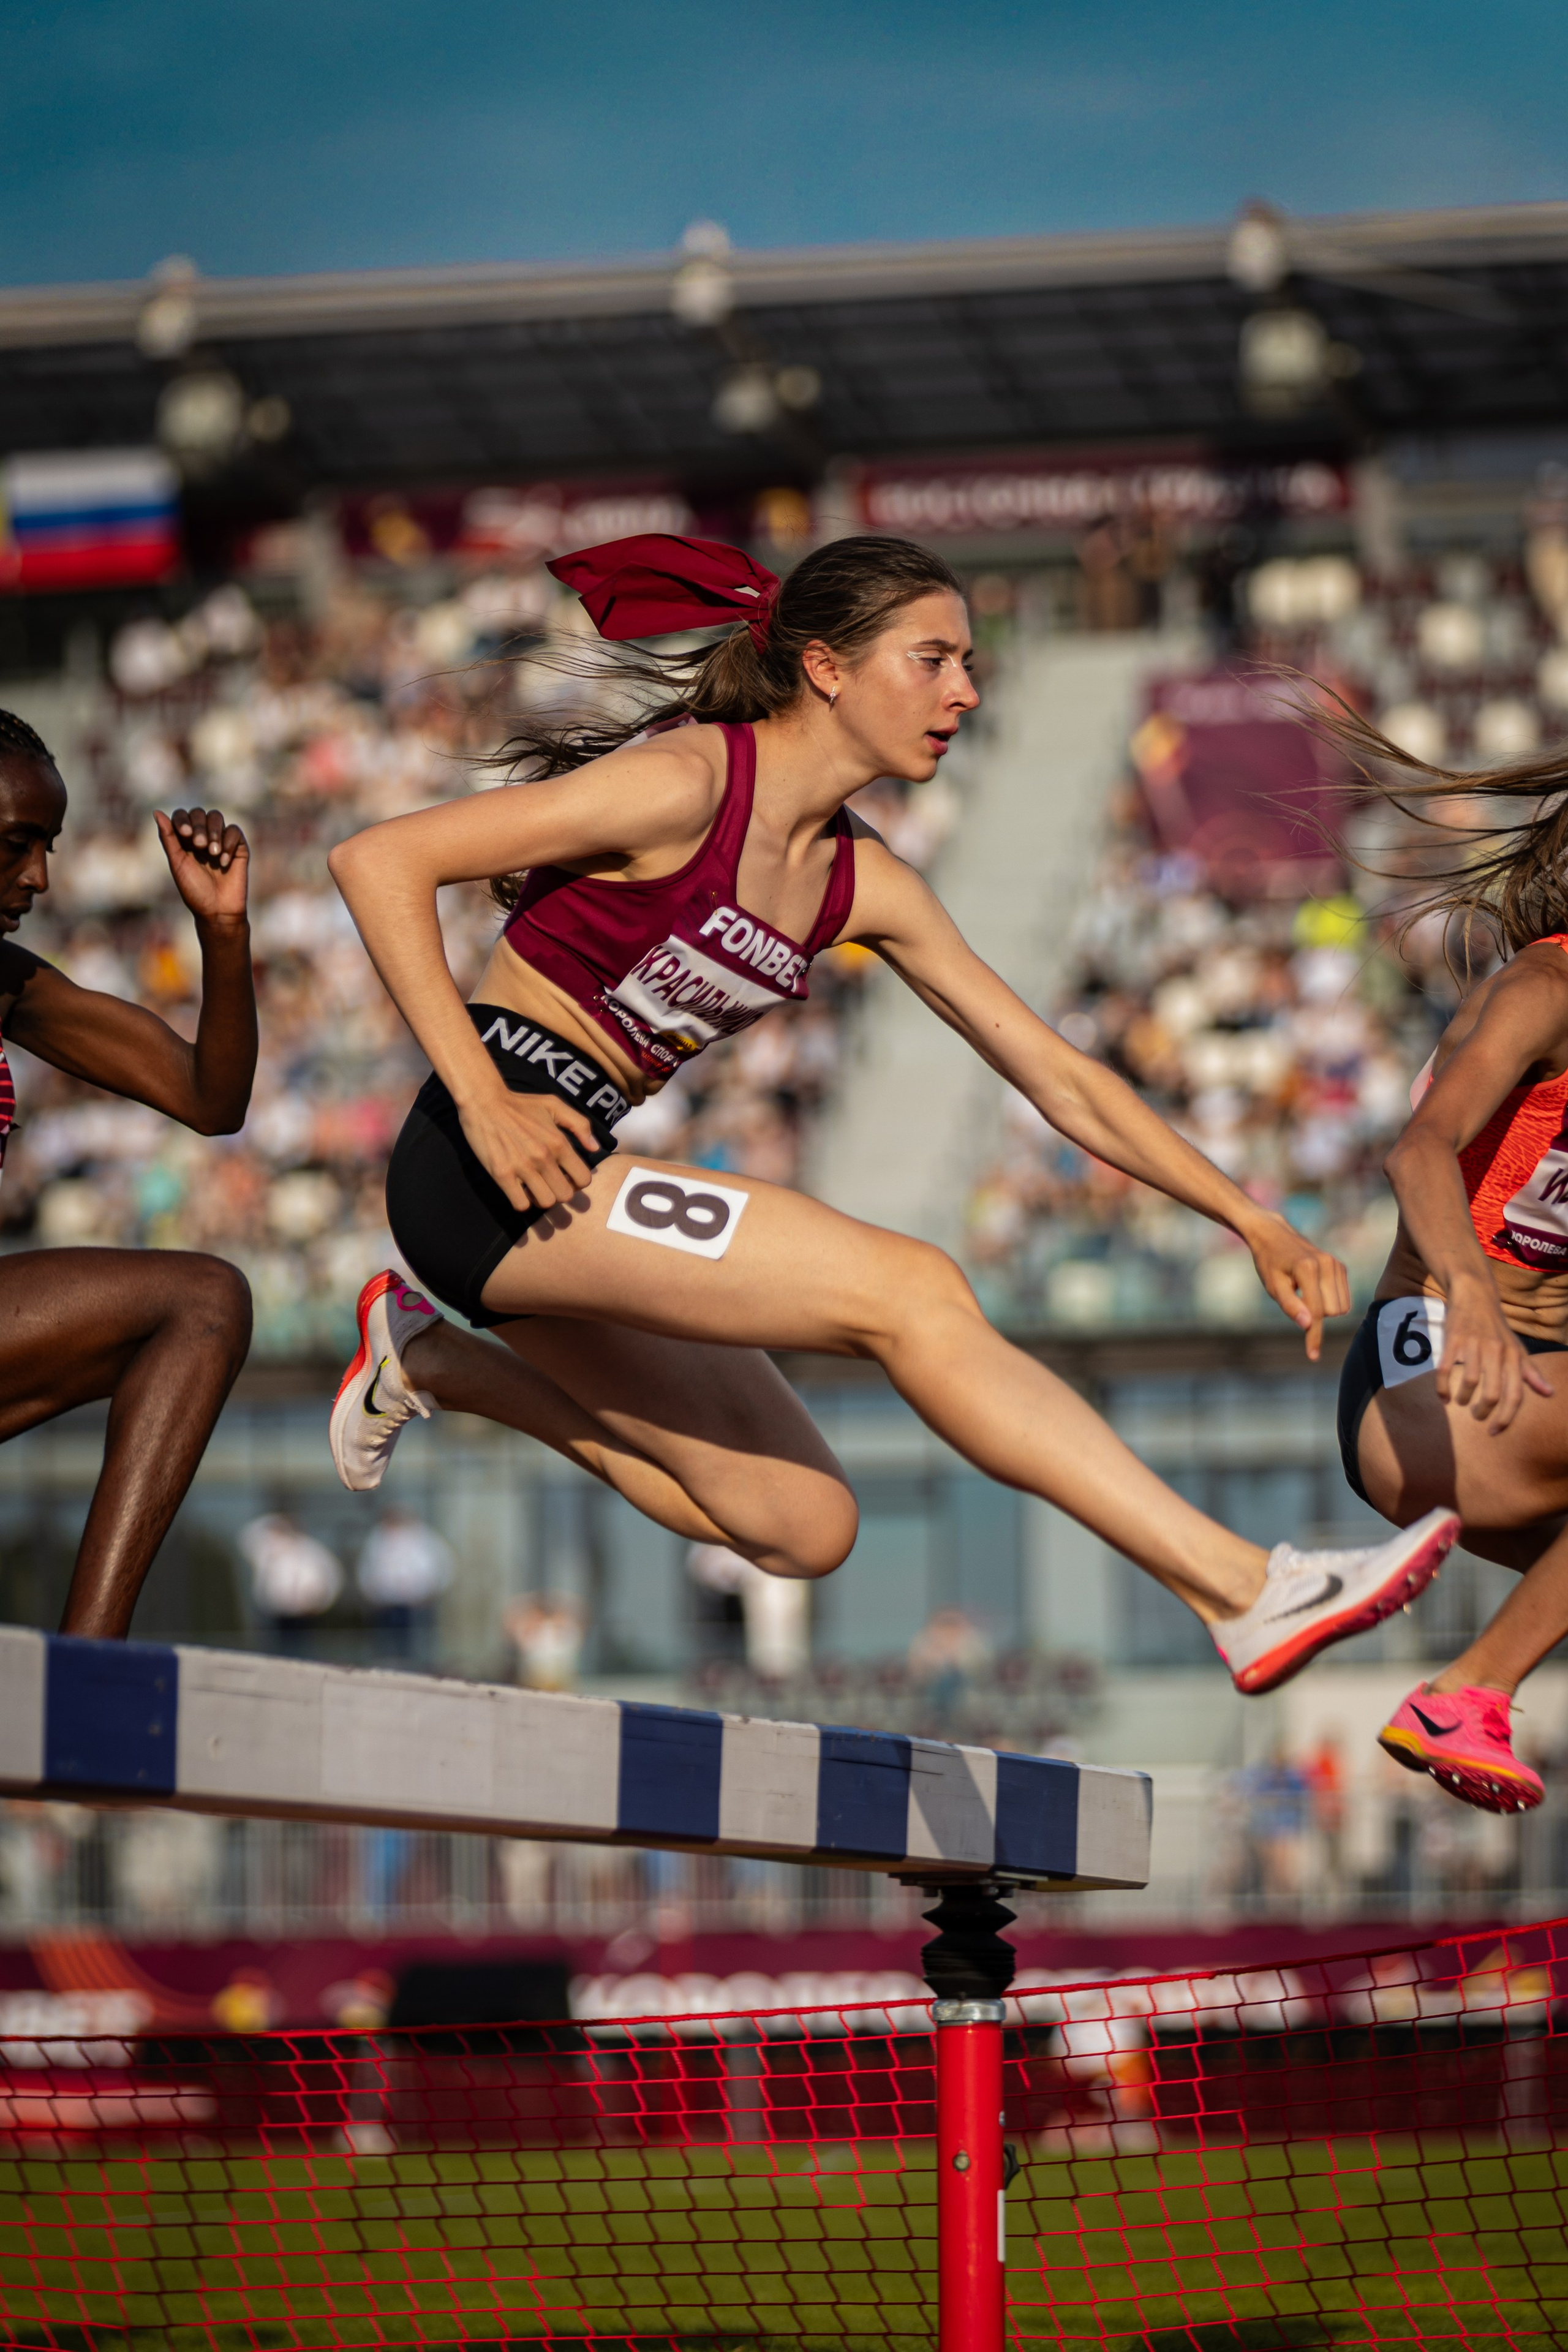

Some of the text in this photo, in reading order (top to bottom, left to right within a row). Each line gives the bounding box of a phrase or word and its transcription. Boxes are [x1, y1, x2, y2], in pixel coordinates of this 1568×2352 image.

[481, 1017, 630, 1126] NIKE PR
[625, 1180, 730, 1240] 8
[1511, 1229, 1567, 1256] КОРОЛЕВА
[1393, 1310, 1432, 1366] 6
